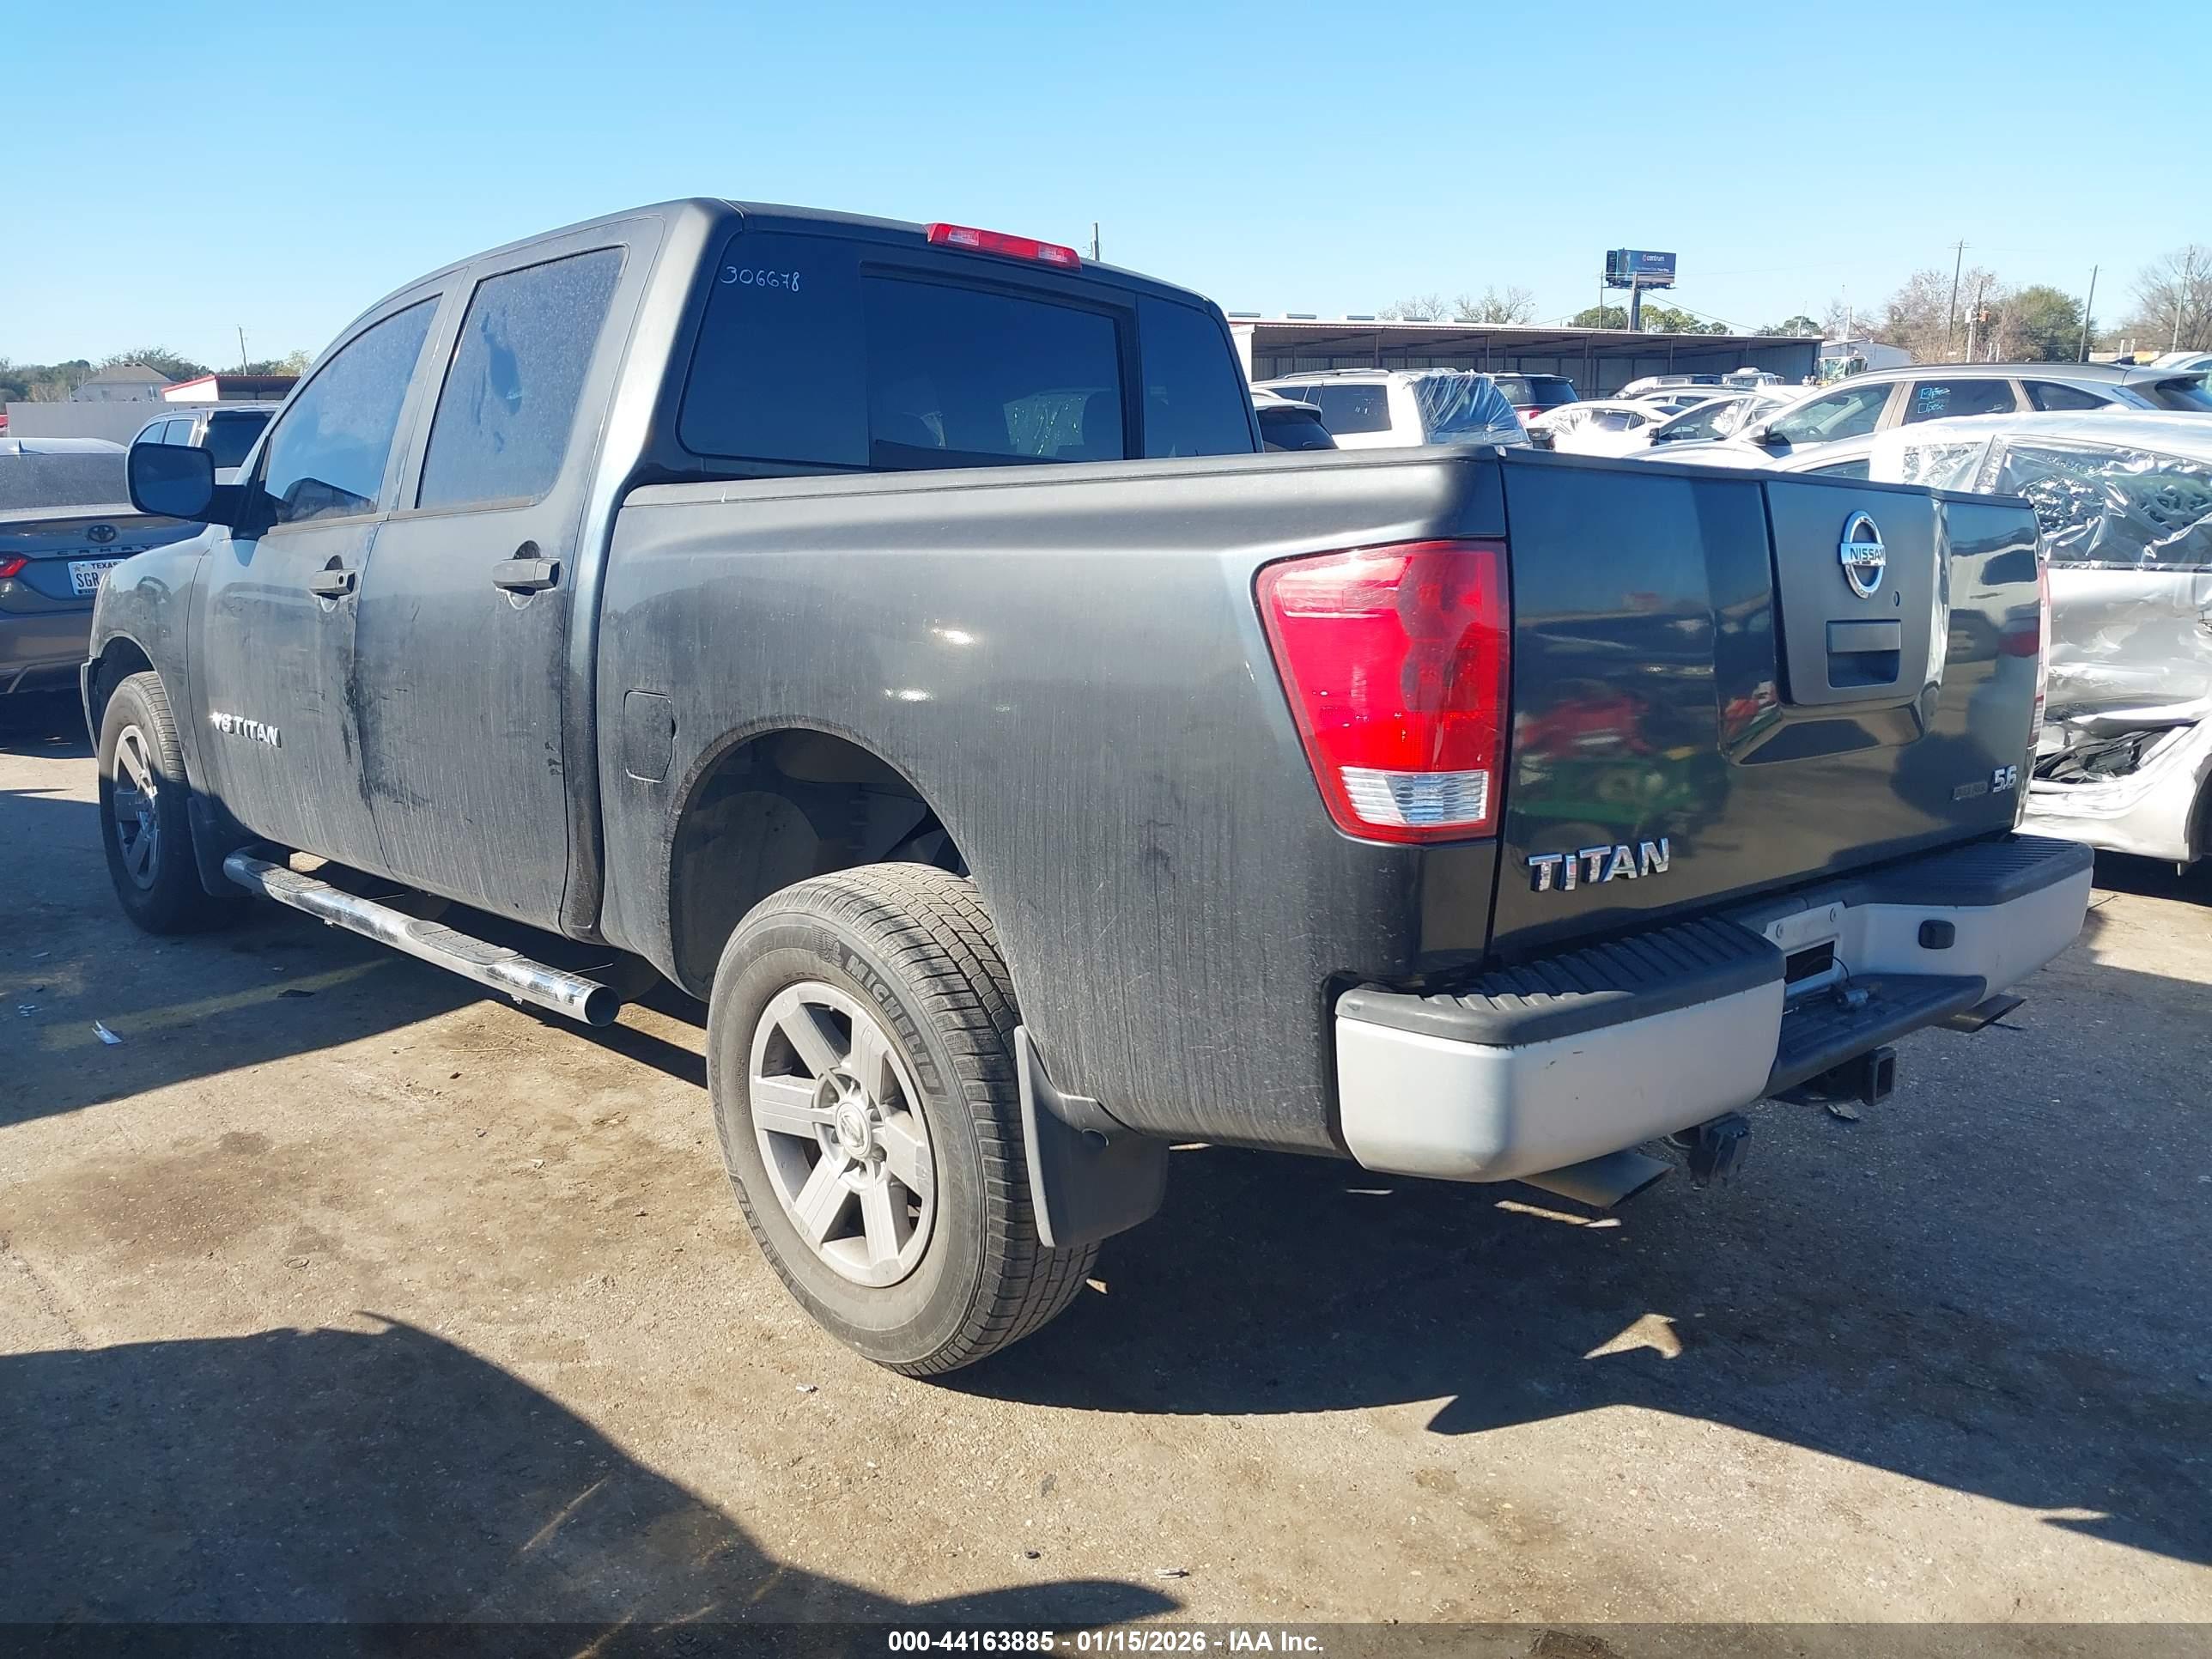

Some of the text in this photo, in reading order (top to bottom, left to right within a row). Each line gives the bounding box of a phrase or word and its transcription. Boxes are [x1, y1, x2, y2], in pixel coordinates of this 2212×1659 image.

[720, 265, 800, 292] 306678
[57, 544, 154, 556] CAMRY
[1850, 548, 1885, 561] NISSAN
[233, 715, 282, 748] TITAN
[1527, 837, 1669, 892] TITAN
[845, 954, 941, 1089] MICHELIN
